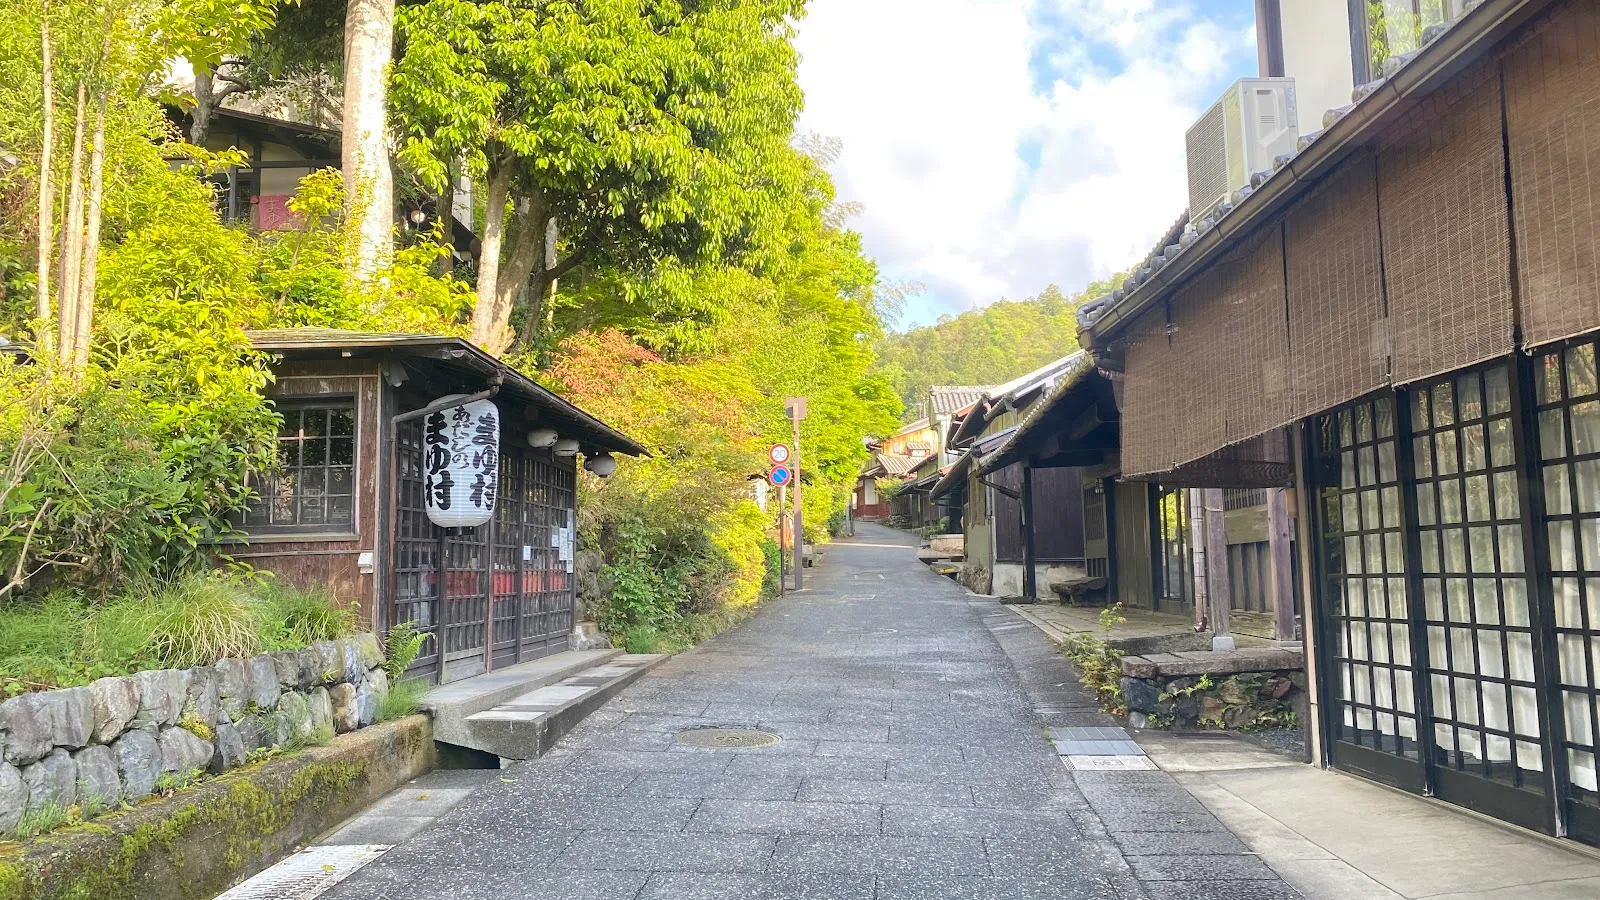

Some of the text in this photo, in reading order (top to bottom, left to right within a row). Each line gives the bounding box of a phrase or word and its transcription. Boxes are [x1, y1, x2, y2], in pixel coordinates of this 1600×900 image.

[425, 411, 456, 511] まゆ村
[450, 405, 475, 470] あだしの
[774, 449, 786, 459] 20
